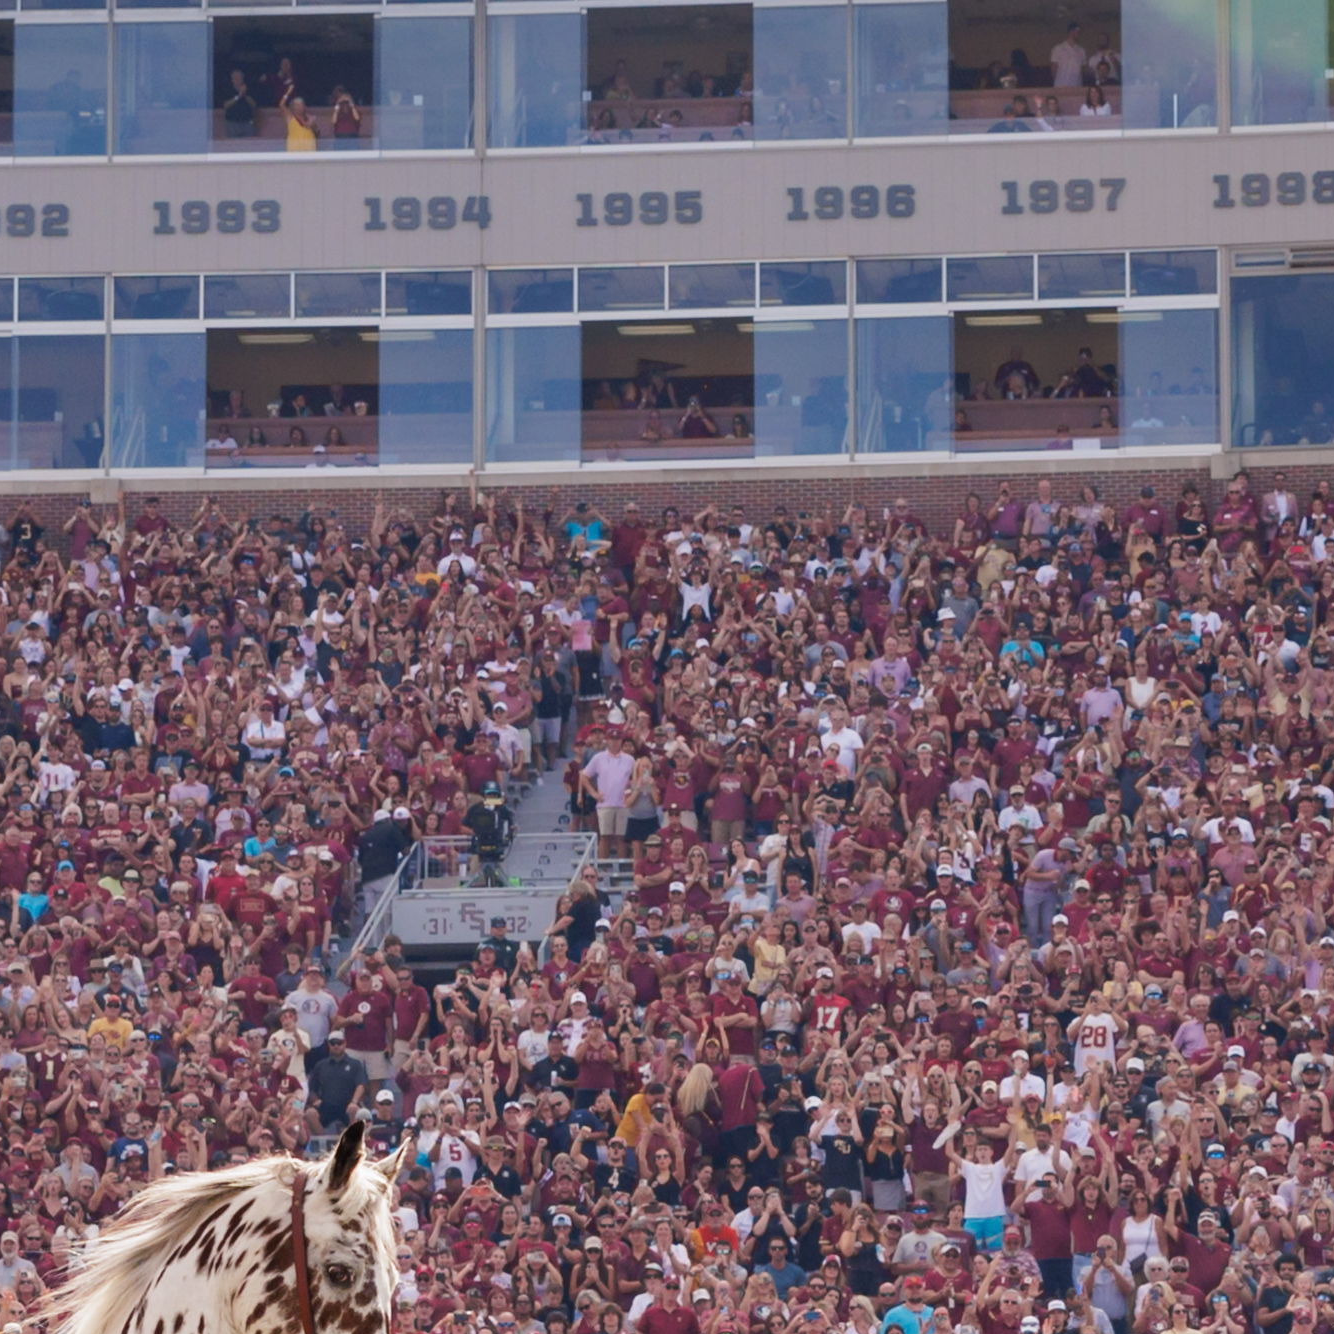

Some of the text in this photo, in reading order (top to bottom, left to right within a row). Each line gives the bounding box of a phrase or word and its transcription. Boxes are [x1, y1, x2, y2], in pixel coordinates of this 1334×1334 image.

[153, 199, 281, 236] 1993
[364, 195, 493, 232] 1994
[575, 190, 703, 228] 1995
[786, 184, 916, 222] 1996
[1000, 177, 1128, 216] 1997
[21, 524, 31, 540] 3
[428, 918, 448, 936] 31
[505, 916, 527, 933] 32
[816, 1006, 842, 1028] 17
[1080, 1025, 1107, 1048] 28
[46, 1059, 55, 1081] 1
[448, 1142, 462, 1162] 5
[833, 1138, 851, 1155] FSU
[607, 1167, 620, 1189] 4
